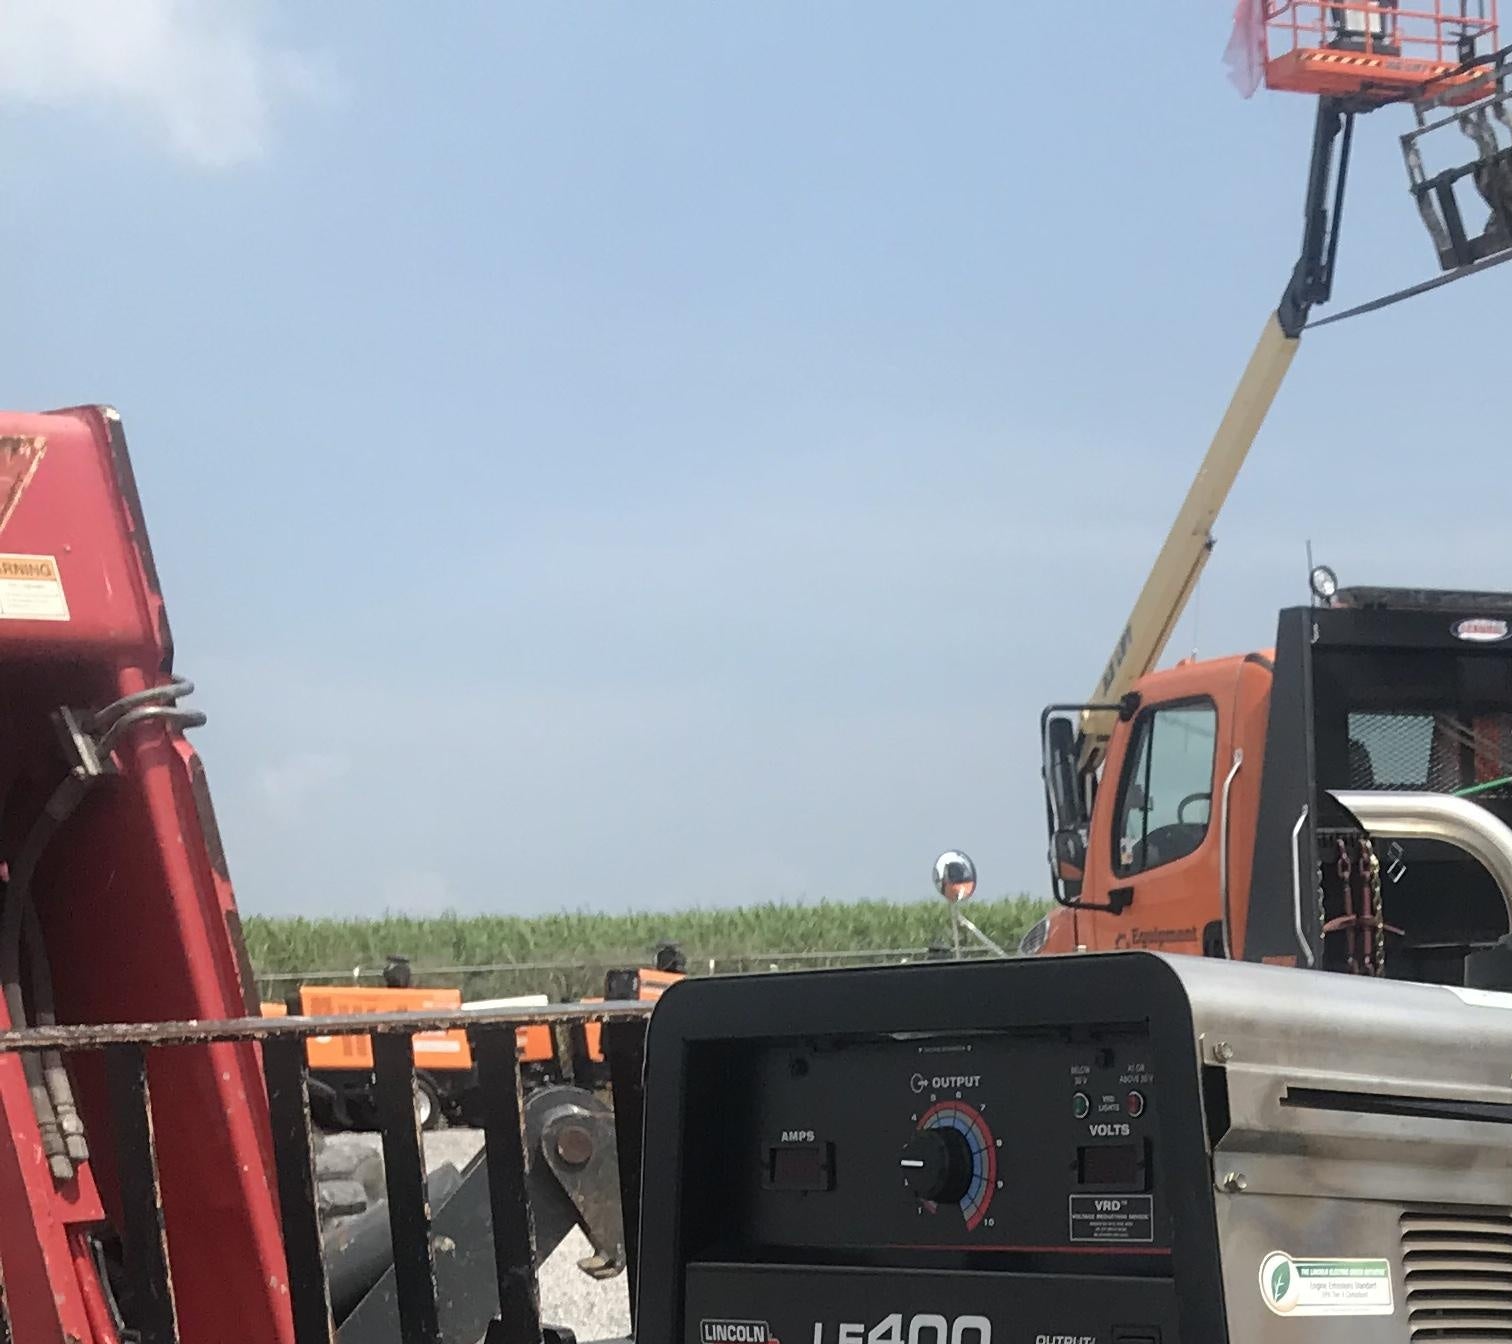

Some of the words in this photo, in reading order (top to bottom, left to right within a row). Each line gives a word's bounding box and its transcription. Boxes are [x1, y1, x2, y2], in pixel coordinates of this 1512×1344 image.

[0, 561, 52, 577] RNING
[932, 1075, 981, 1089] OUTPUT
[781, 1130, 815, 1142] AMPS
[1089, 1124, 1131, 1136] VOLTS
[984, 1218, 995, 1226] 10
[705, 1323, 765, 1343] LINCOLN
